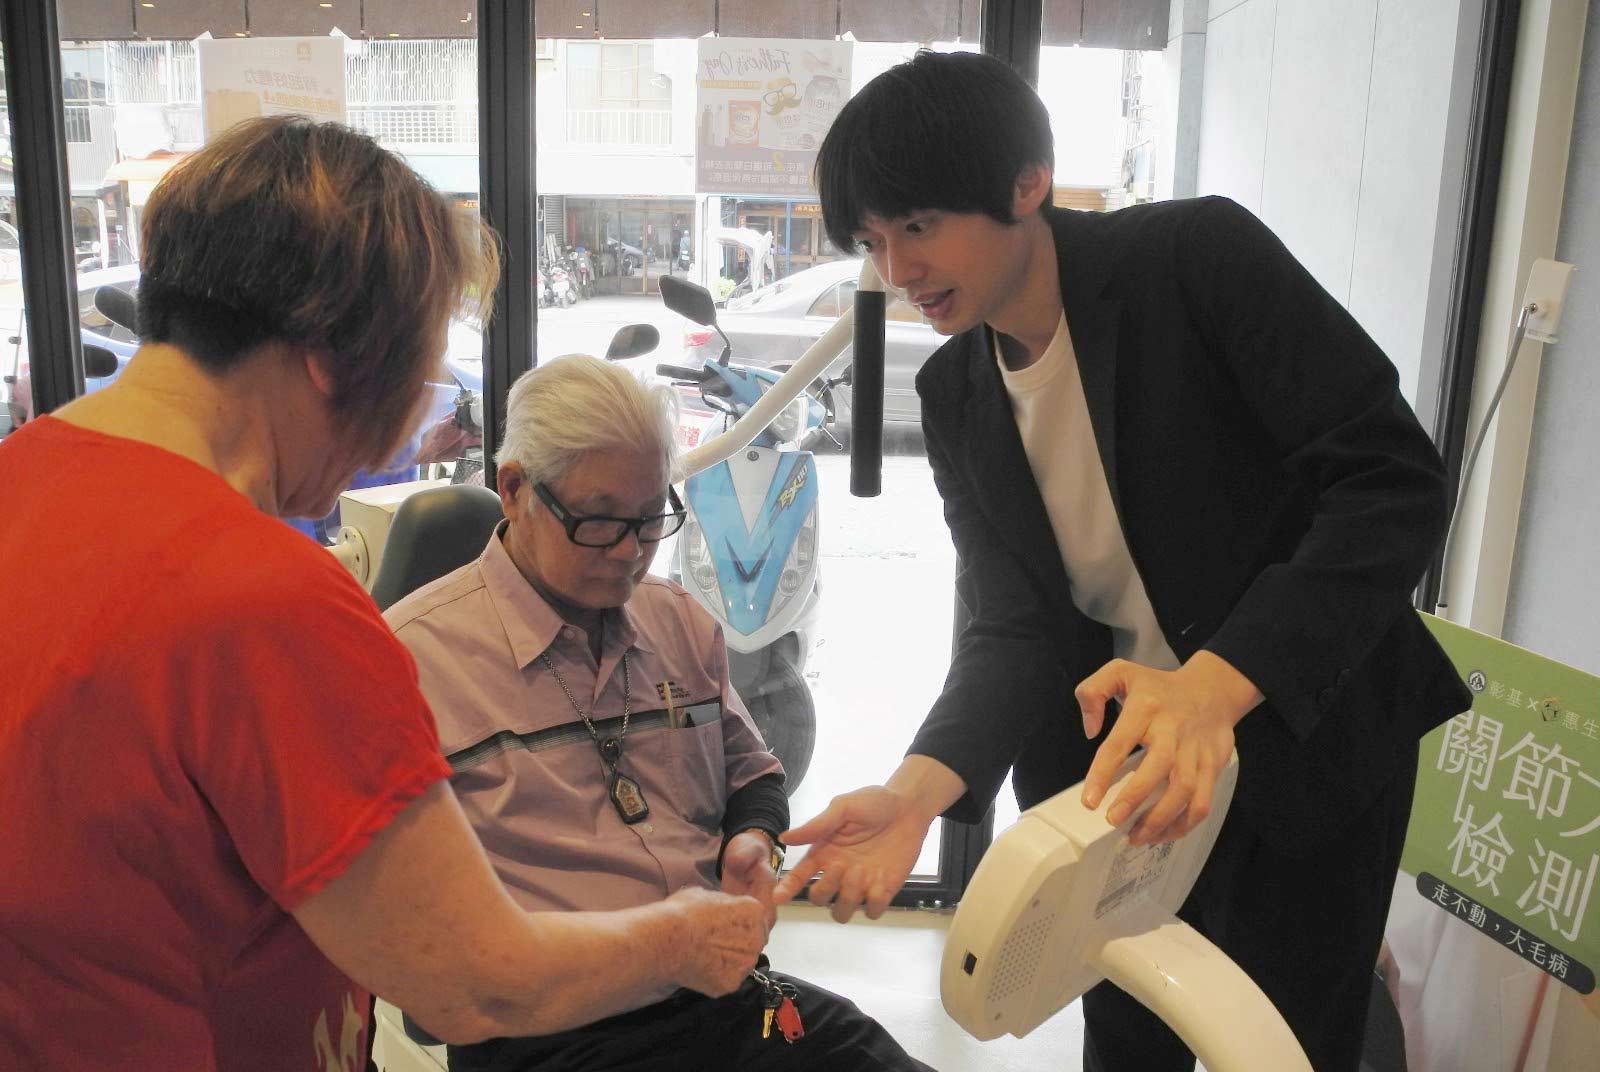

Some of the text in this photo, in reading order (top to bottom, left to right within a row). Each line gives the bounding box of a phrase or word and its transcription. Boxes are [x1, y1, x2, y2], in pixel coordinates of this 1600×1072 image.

[1432, 883, 1569, 979] 走不動，大毛病
[1447, 803, 1600, 943] 檢測
